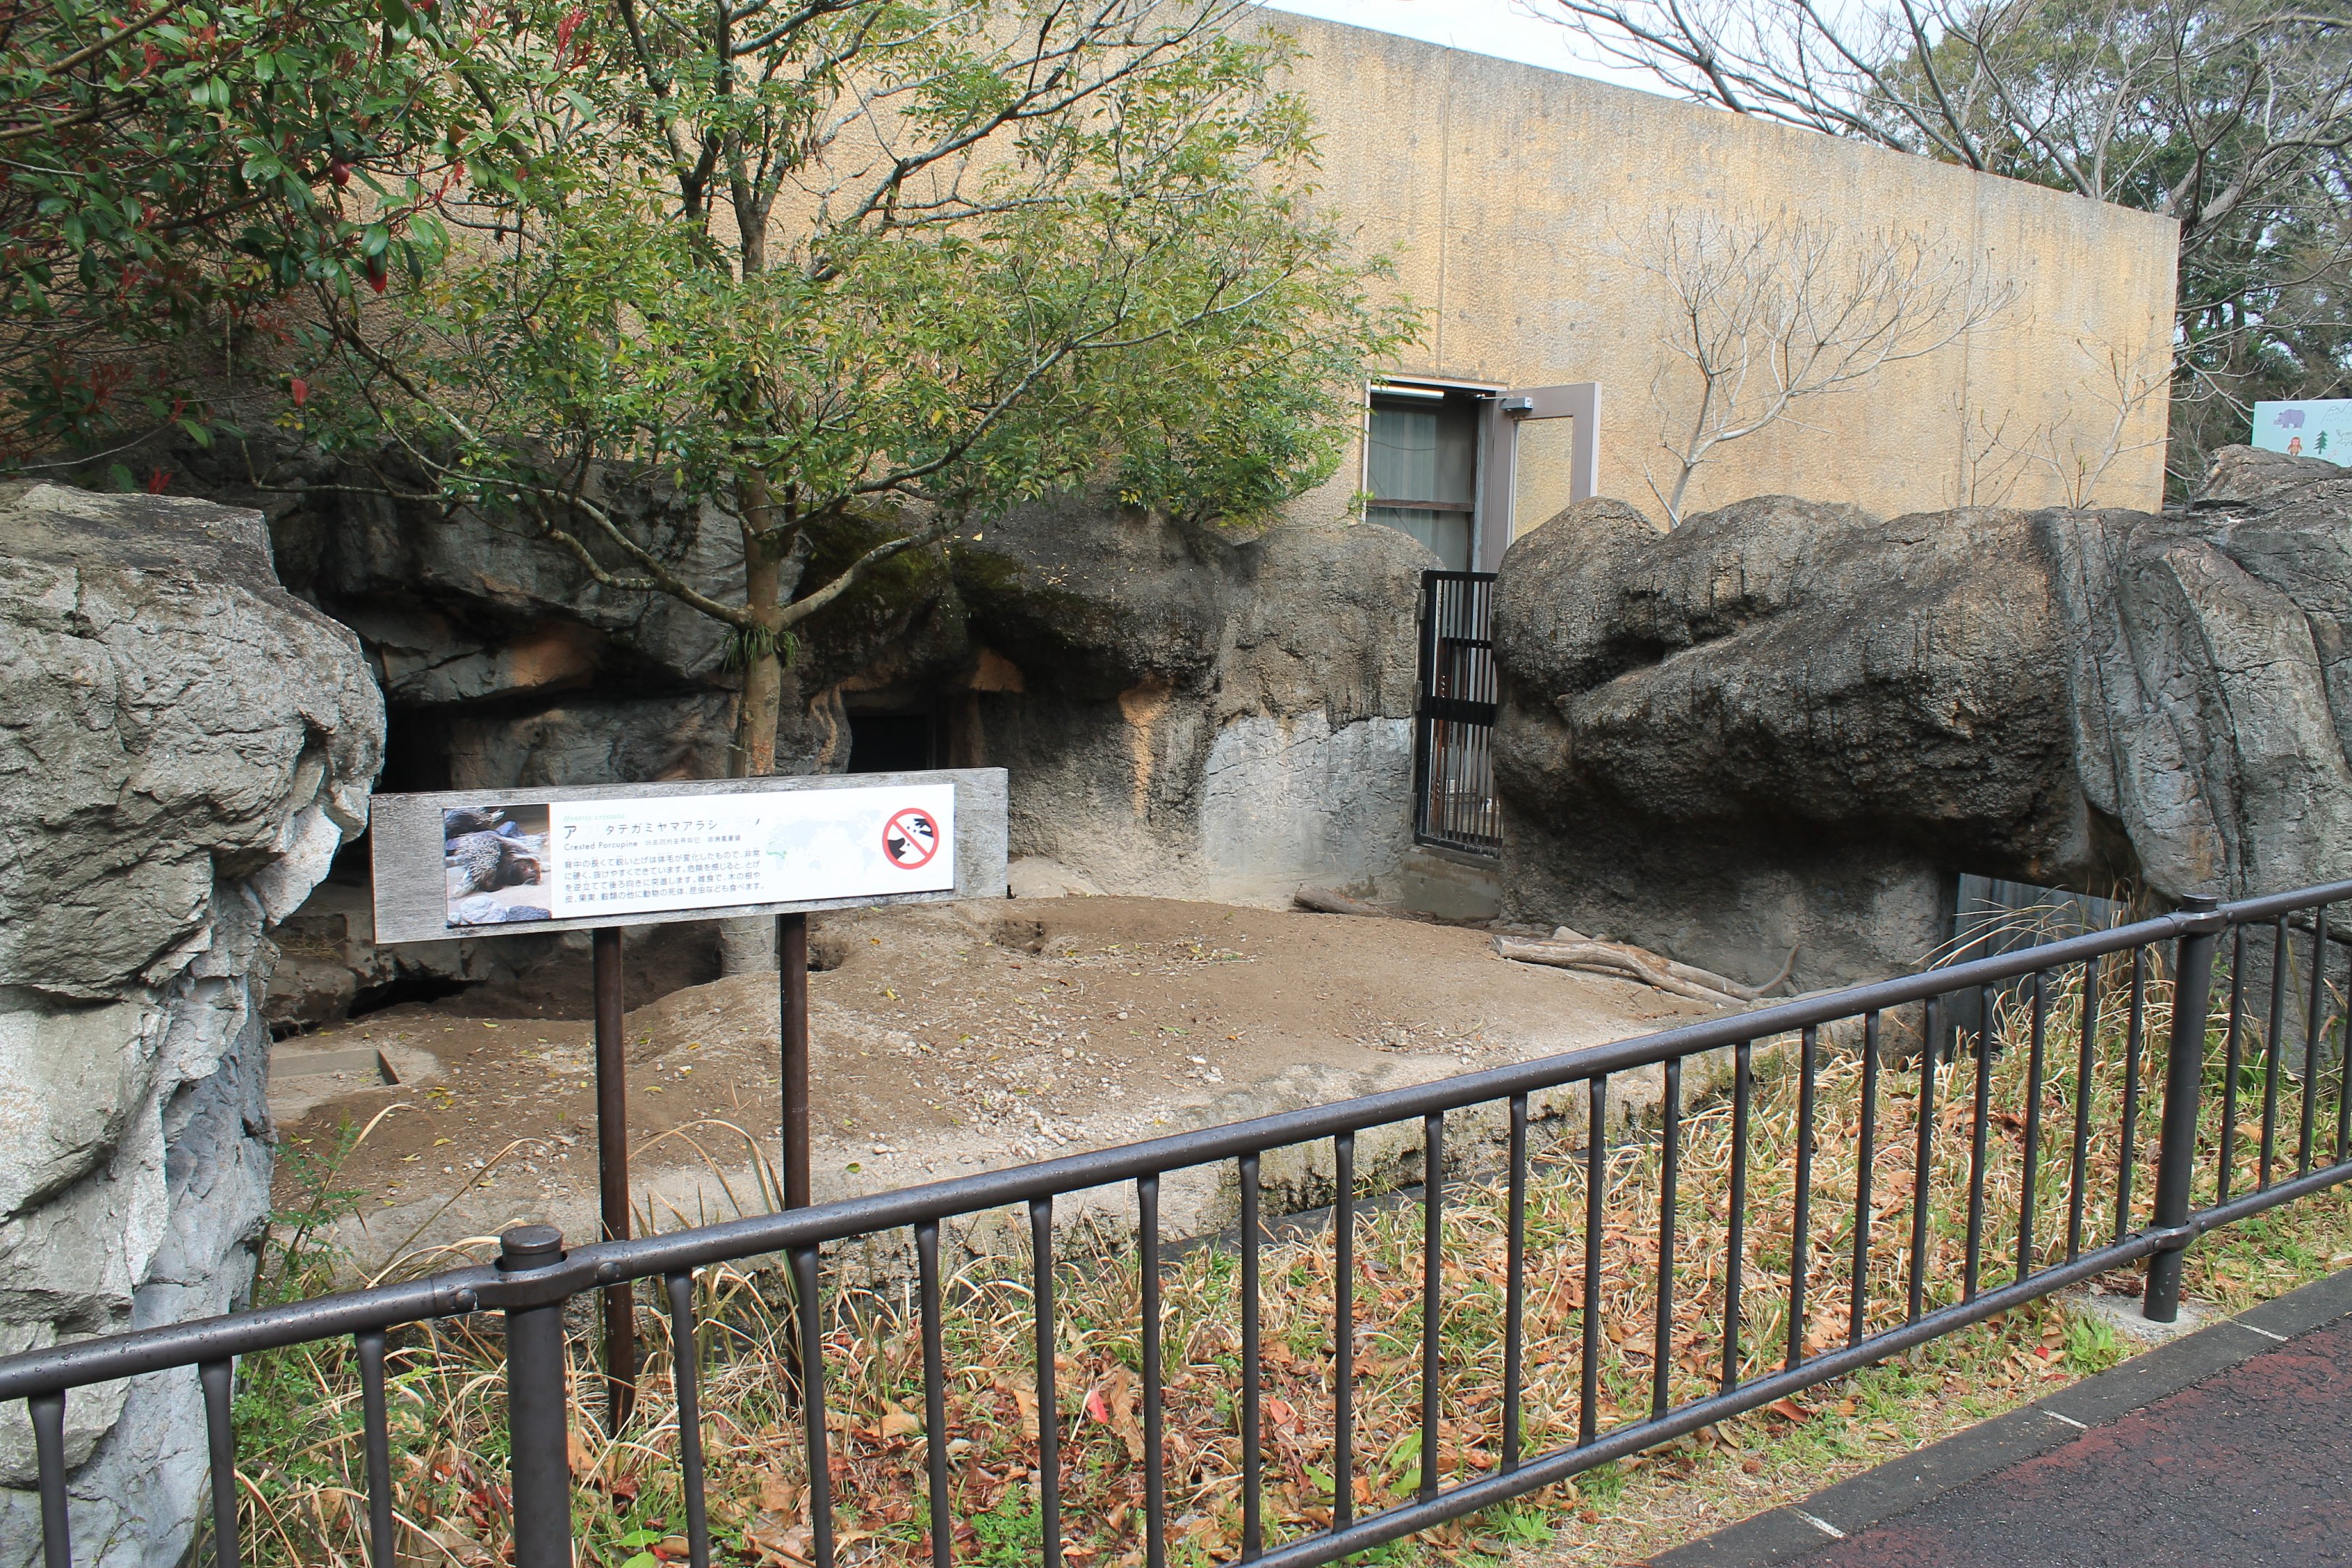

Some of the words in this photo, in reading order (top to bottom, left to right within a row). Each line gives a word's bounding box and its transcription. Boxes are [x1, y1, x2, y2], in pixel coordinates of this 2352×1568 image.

[605, 819, 719, 836] タテガミヤマアラシ
[563, 841, 595, 851] Crested
[597, 840, 638, 850] Porcupine
